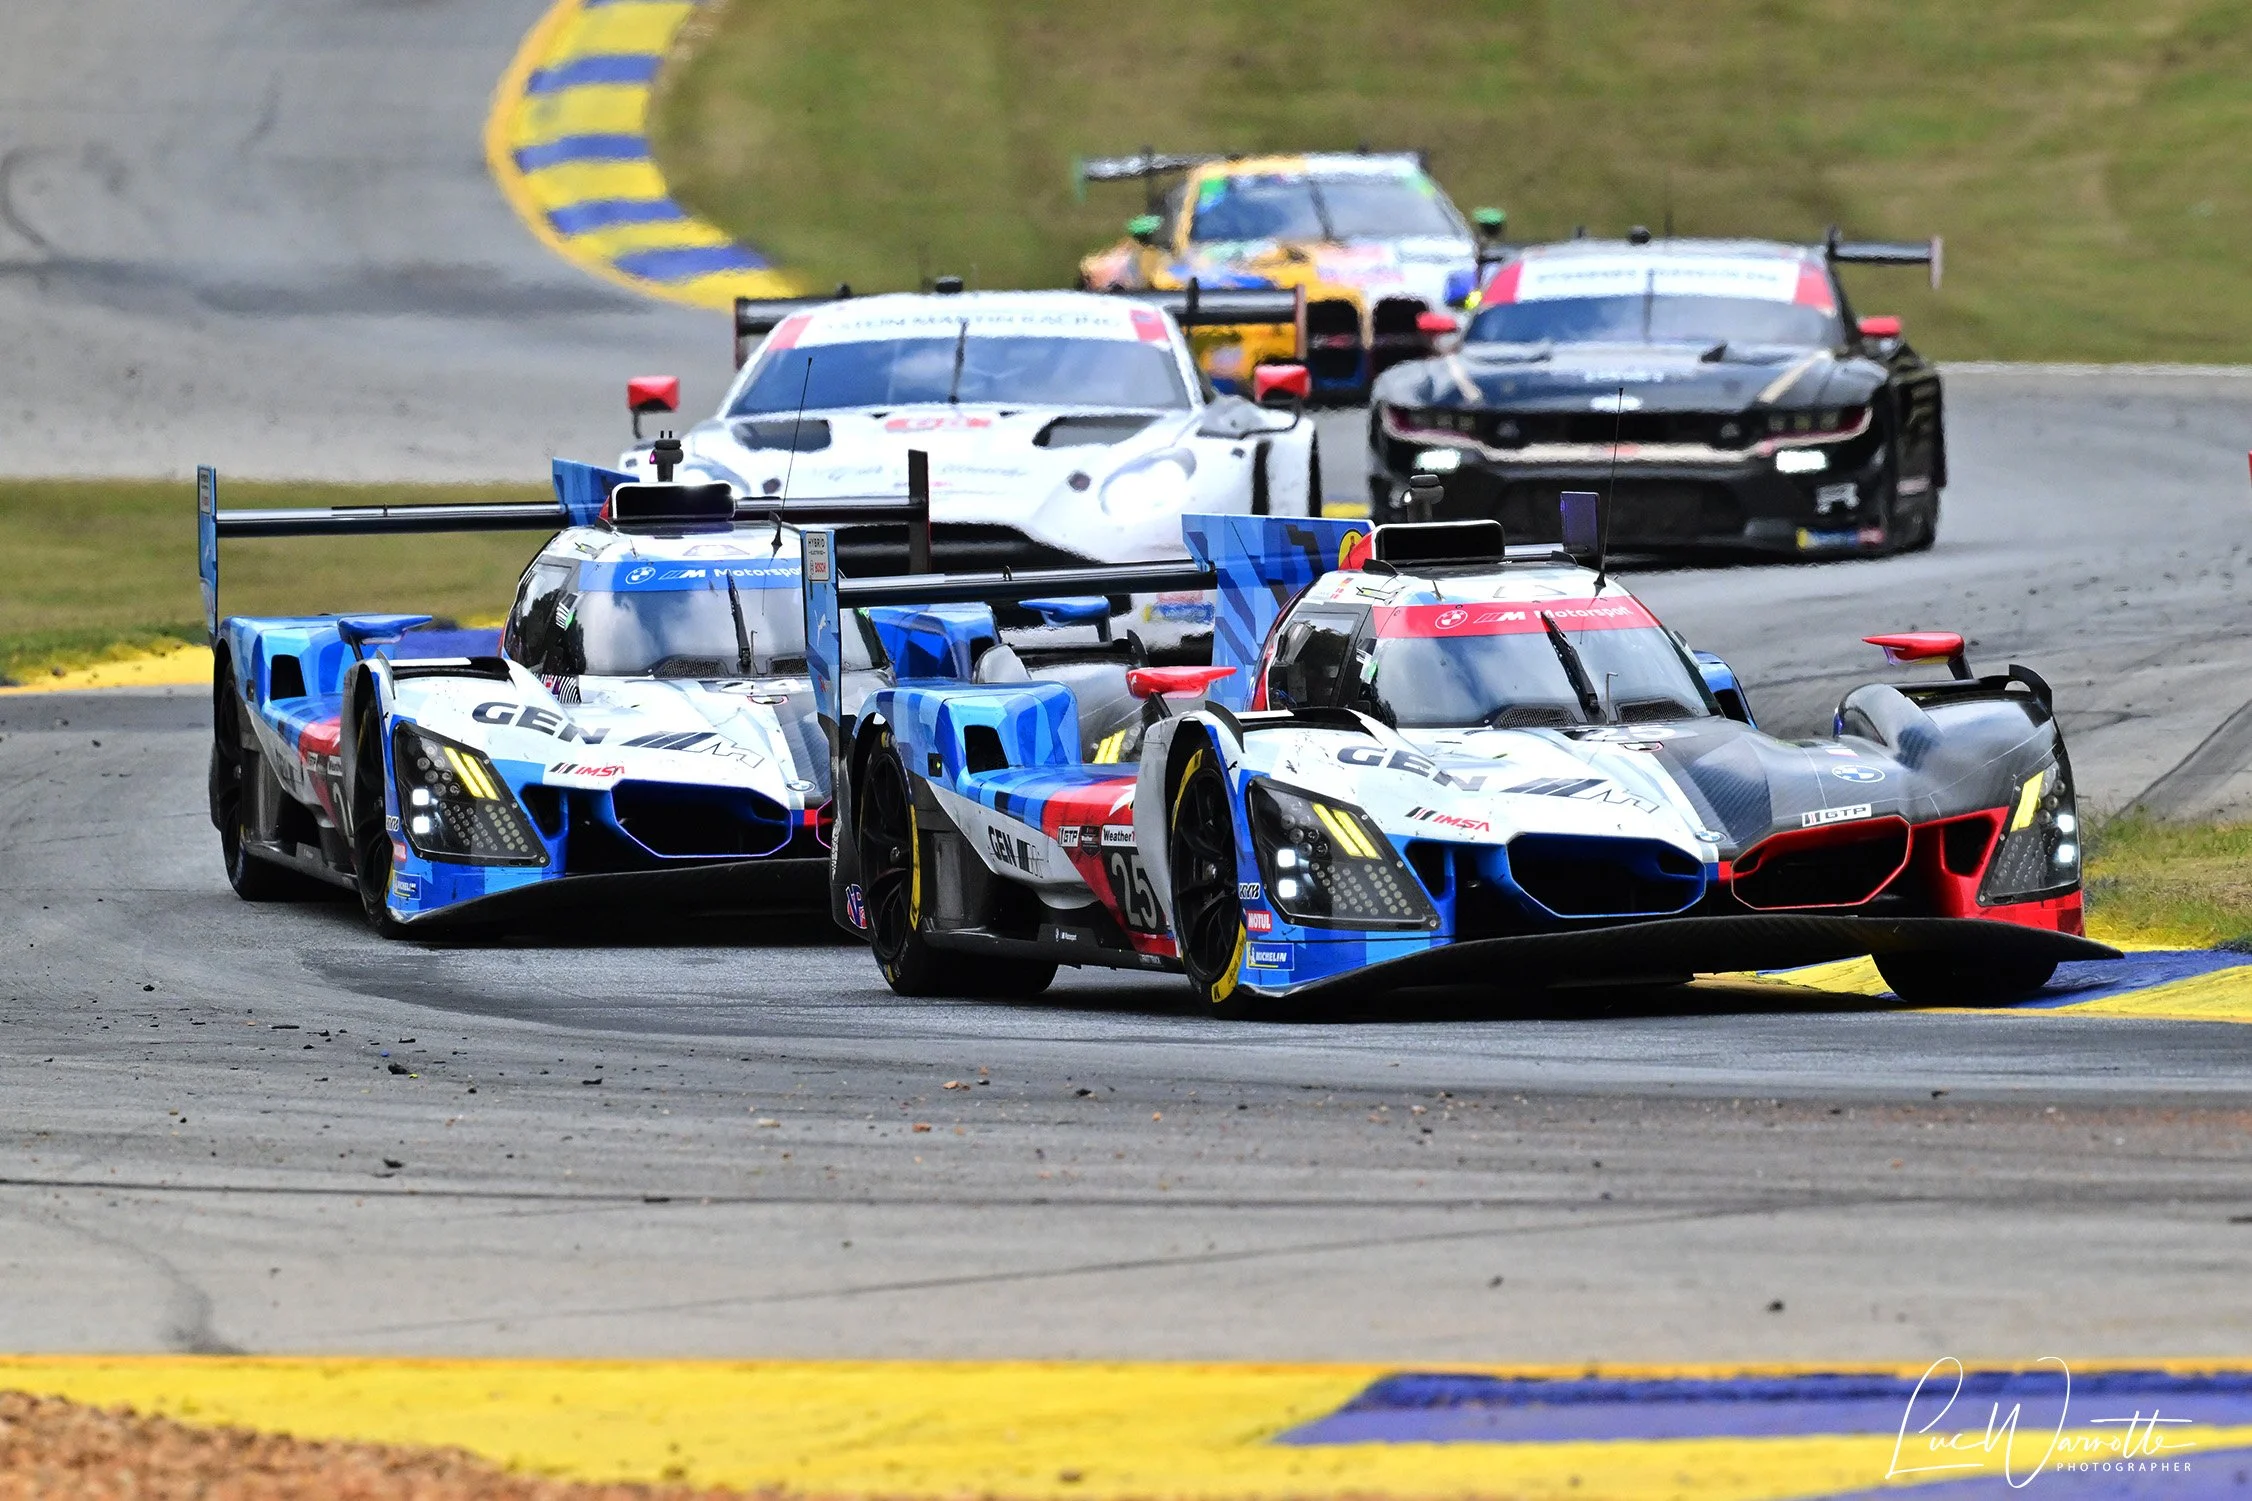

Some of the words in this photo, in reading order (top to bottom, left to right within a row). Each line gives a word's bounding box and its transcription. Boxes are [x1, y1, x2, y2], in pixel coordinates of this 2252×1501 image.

[1533, 605, 1634, 619] Motorsport
[471, 701, 612, 745] GEN
[1337, 745, 1489, 791] GEN
[1824, 807, 1867, 819] GTP
[1432, 814, 1490, 832] IMSA
[1063, 830, 1079, 843] GTP
[1111, 852, 1158, 929] 25
[1248, 913, 1270, 929] MOTUL
[1255, 951, 1287, 962] MICHELIN
